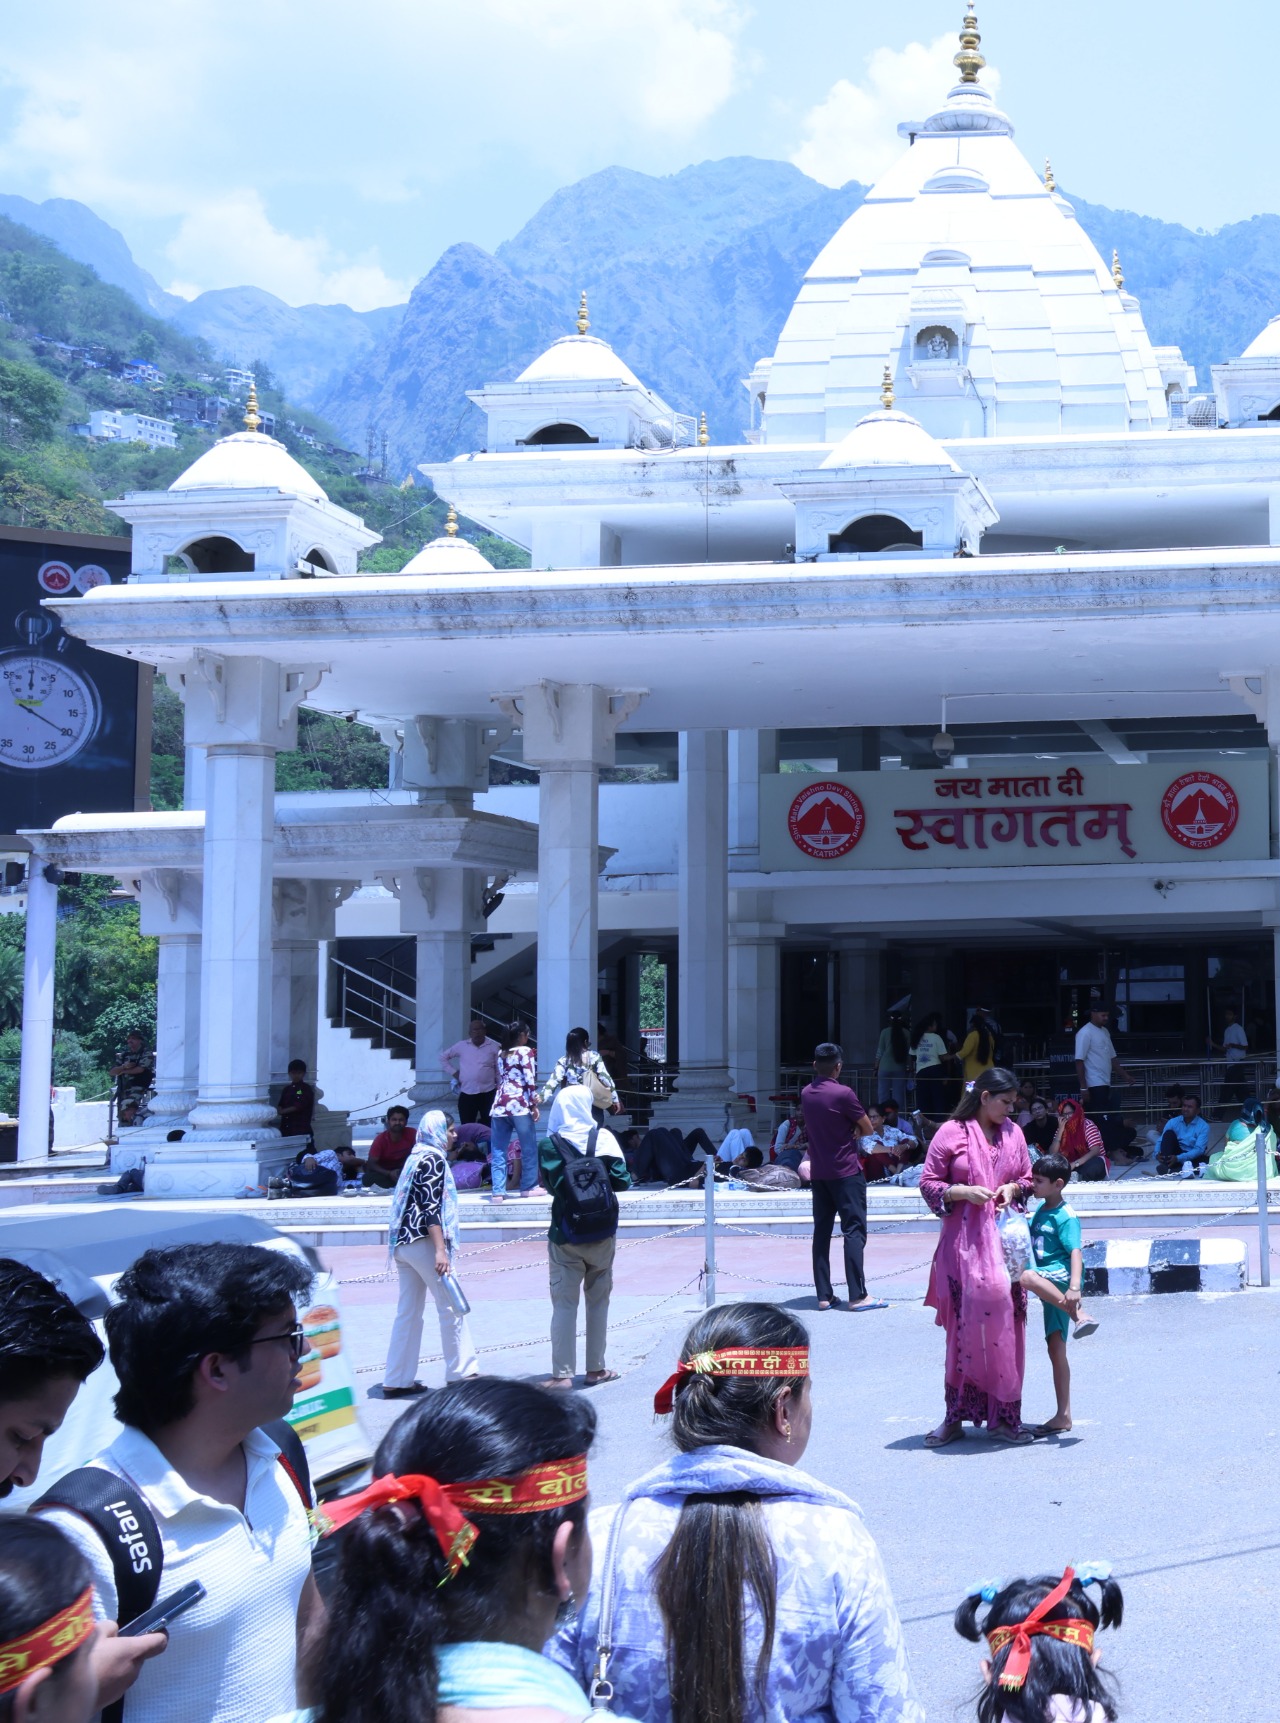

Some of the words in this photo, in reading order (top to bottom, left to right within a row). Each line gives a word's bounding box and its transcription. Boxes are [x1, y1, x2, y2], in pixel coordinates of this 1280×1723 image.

[68, 709, 78, 717] 15
[61, 728, 73, 736] 20
[1, 739, 13, 747] 35
[22, 745, 35, 754] 30
[44, 742, 57, 750] 25
[826, 783, 843, 793] Devi
[934, 778, 983, 799] जय
[987, 776, 1051, 797] माता
[1056, 767, 1084, 796] दी
[797, 785, 825, 803] Vaishno
[843, 790, 860, 812] Shrine
[790, 804, 800, 823] Mata
[790, 824, 801, 840] Shri
[852, 814, 863, 838] Board
[893, 803, 1137, 859] स्वागतम्
[813, 849, 840, 857] KATRA
[761, 1355, 782, 1370] दी
[464, 1480, 517, 1504] से
[103, 1500, 153, 1574] safari
